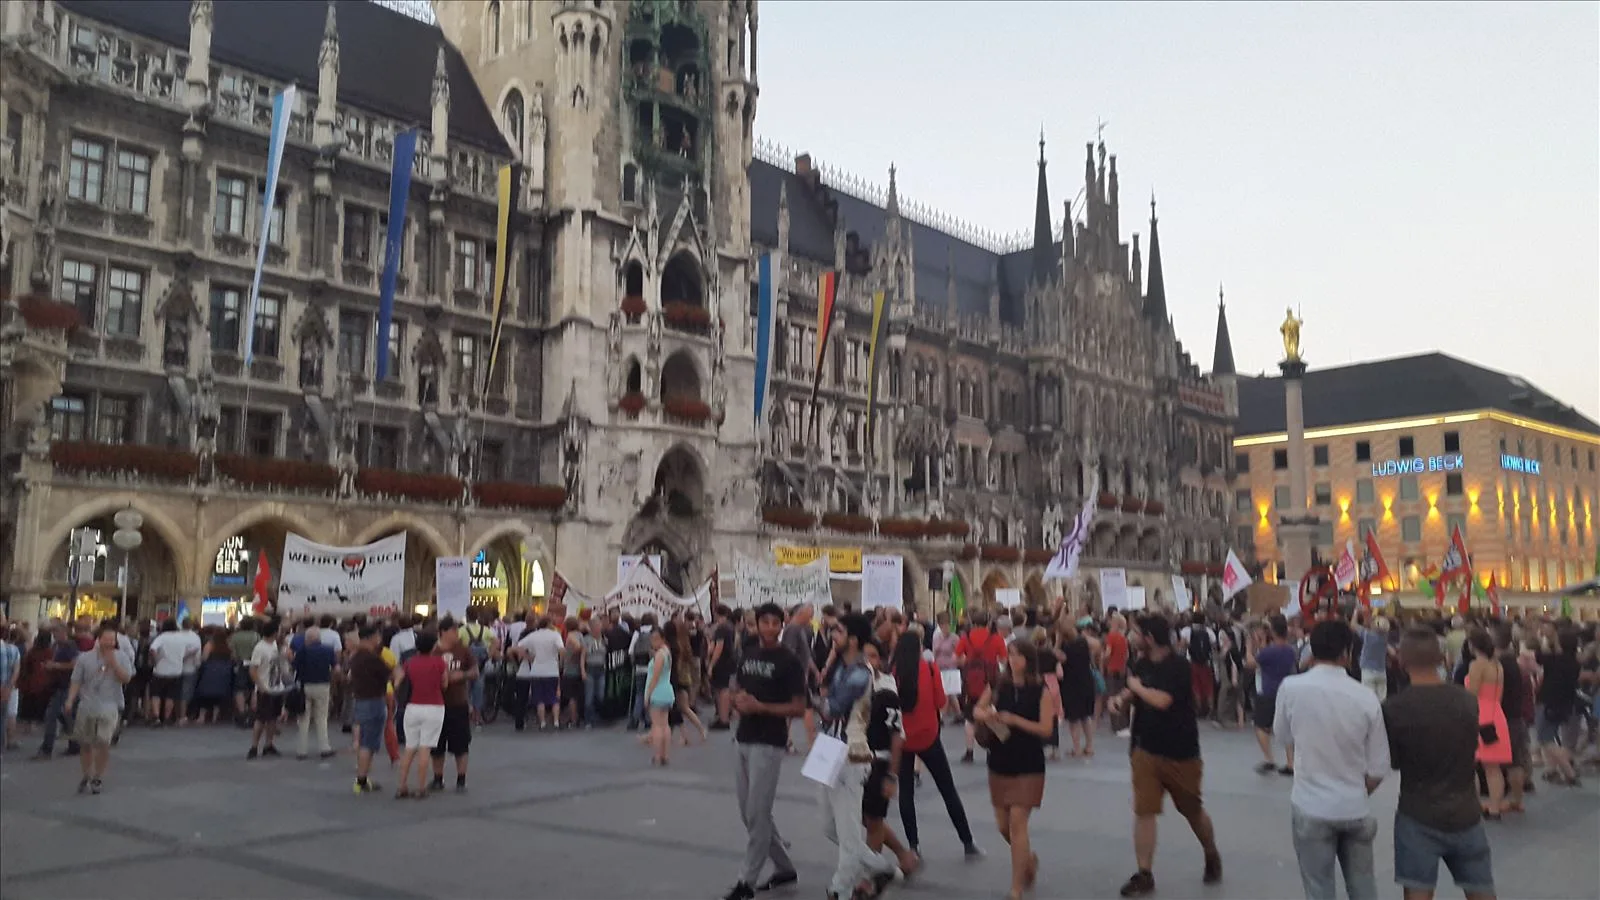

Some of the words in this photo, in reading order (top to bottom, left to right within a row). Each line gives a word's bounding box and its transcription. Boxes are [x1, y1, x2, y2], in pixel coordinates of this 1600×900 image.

[1372, 457, 1425, 477] LUDWIG
[1429, 454, 1464, 472] BECK
[288, 551, 338, 566] WEHRT
[368, 552, 403, 565] EUCH
[781, 547, 794, 559] Wir
[215, 560, 239, 574] GER
[471, 562, 490, 576] TIK
